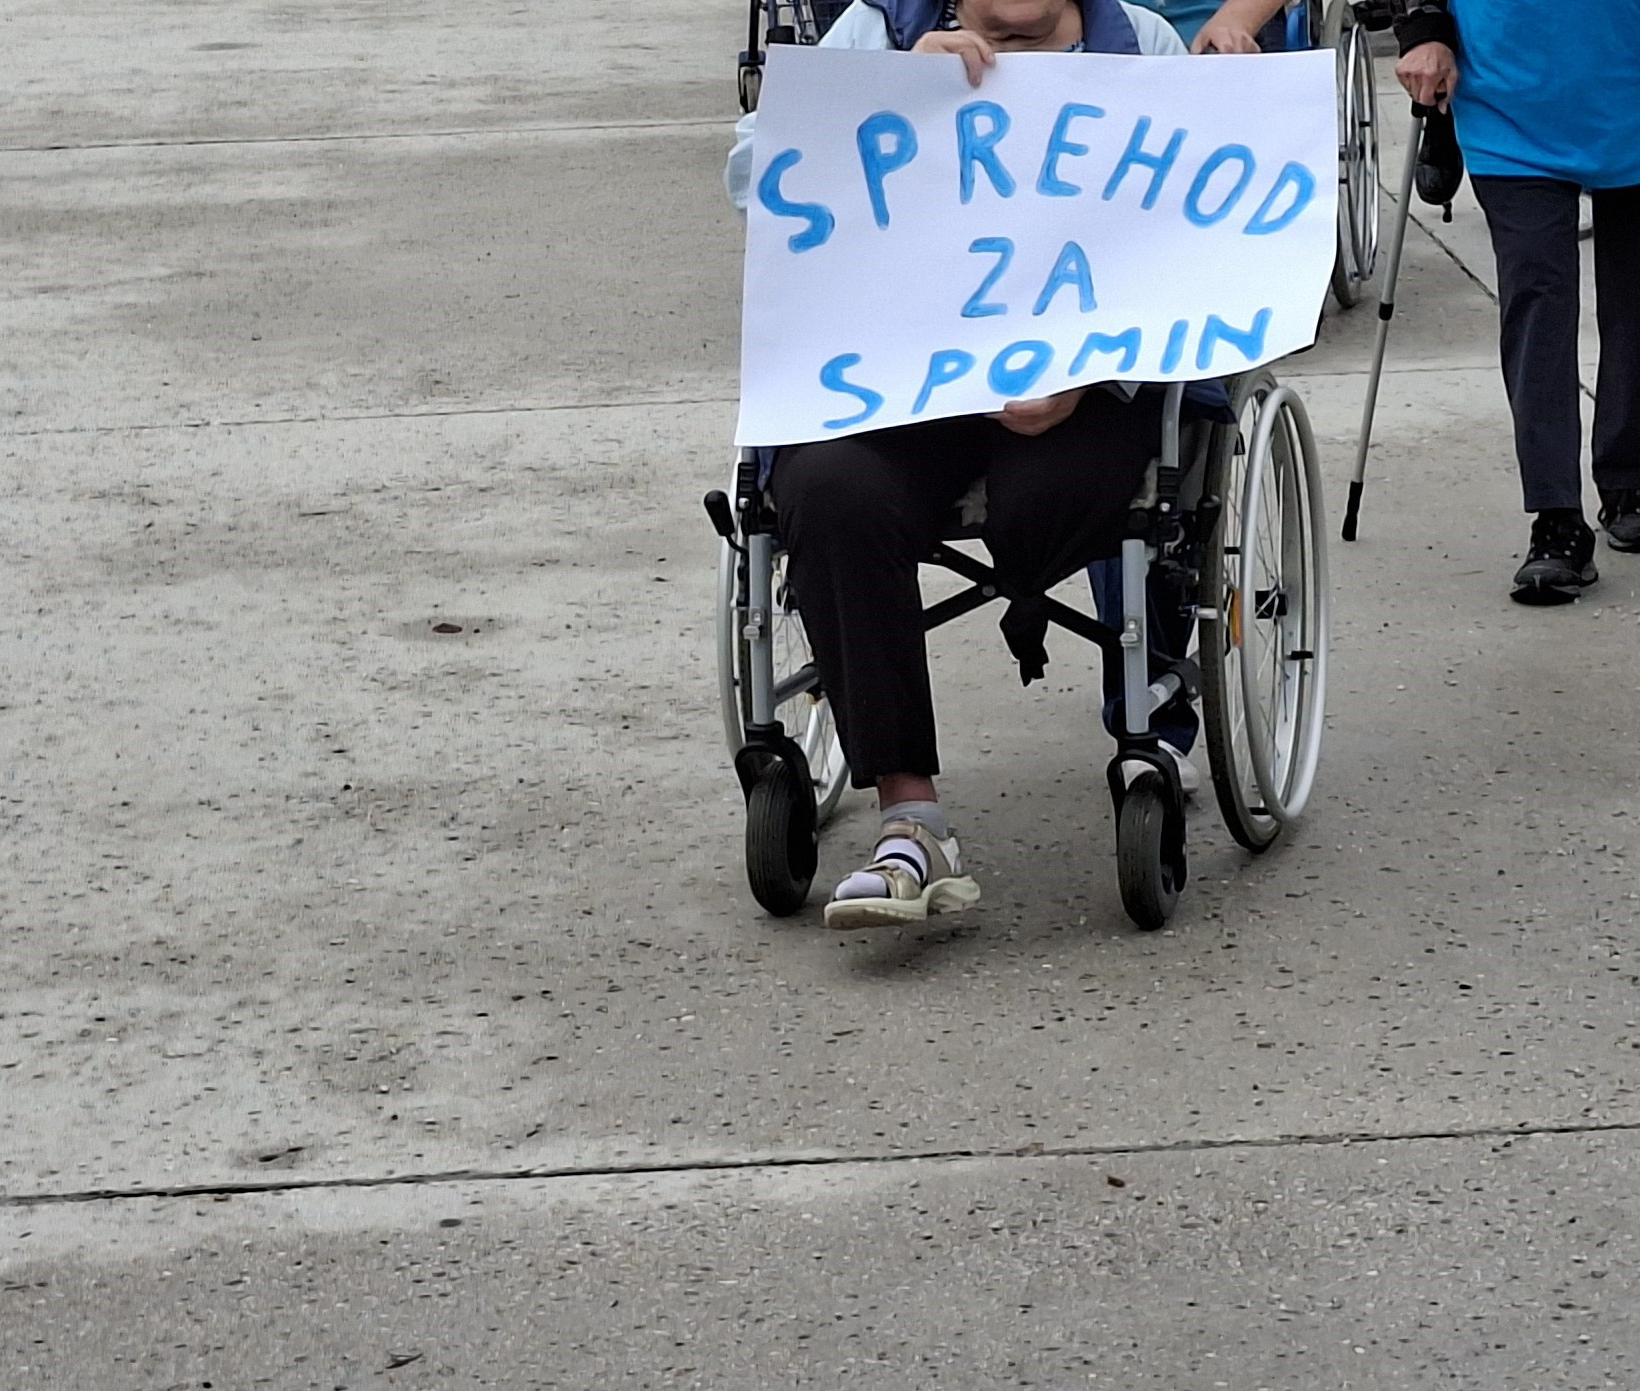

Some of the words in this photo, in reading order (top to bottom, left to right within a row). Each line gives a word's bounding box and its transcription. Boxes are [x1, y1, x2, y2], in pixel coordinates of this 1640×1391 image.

[756, 99, 1317, 255] SPREHOD
[960, 236, 1098, 319] ZA
[818, 307, 1273, 431] SPOMIN
